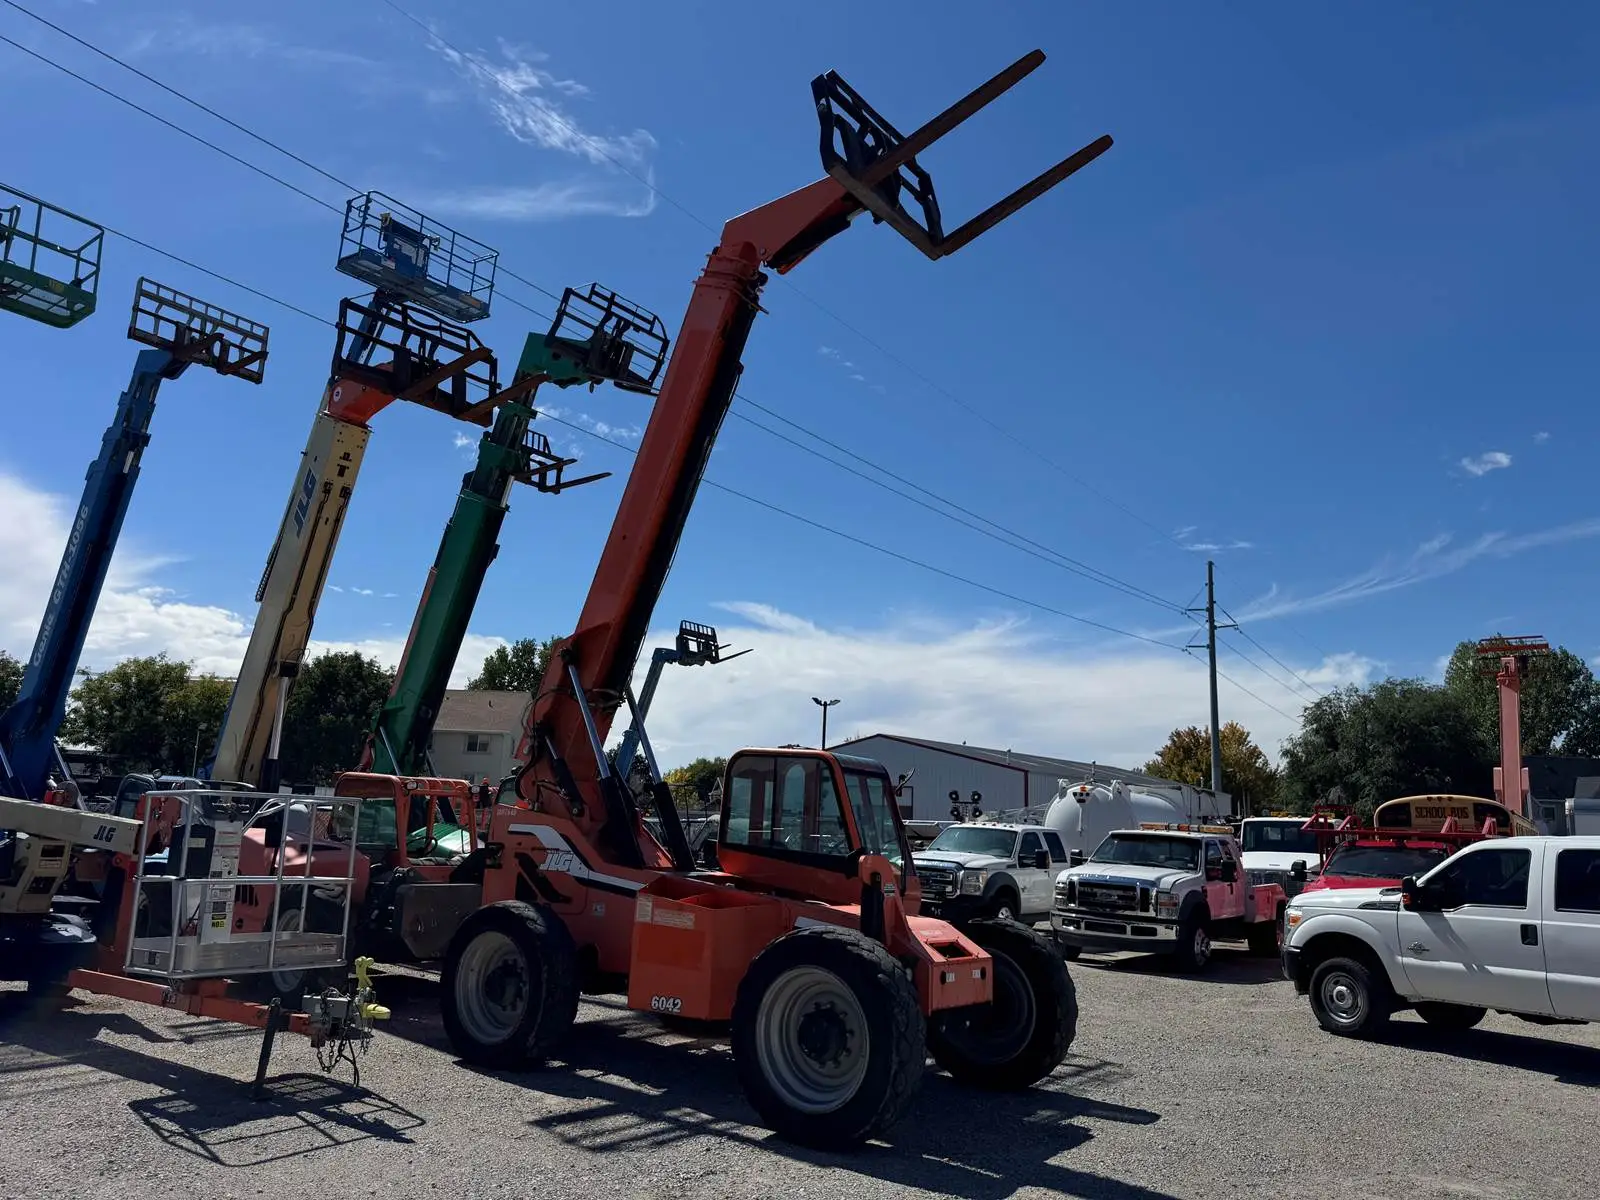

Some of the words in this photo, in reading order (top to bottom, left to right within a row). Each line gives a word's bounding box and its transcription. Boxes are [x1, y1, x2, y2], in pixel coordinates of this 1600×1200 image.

[293, 465, 317, 539] JLG
[33, 614, 55, 667] Genie
[53, 504, 89, 605] GTH-1056
[1415, 806, 1448, 819] SCHOOL
[1450, 806, 1470, 819] BUS
[93, 824, 117, 843] JLG
[540, 852, 574, 872] JLG
[651, 995, 682, 1013] 6042
